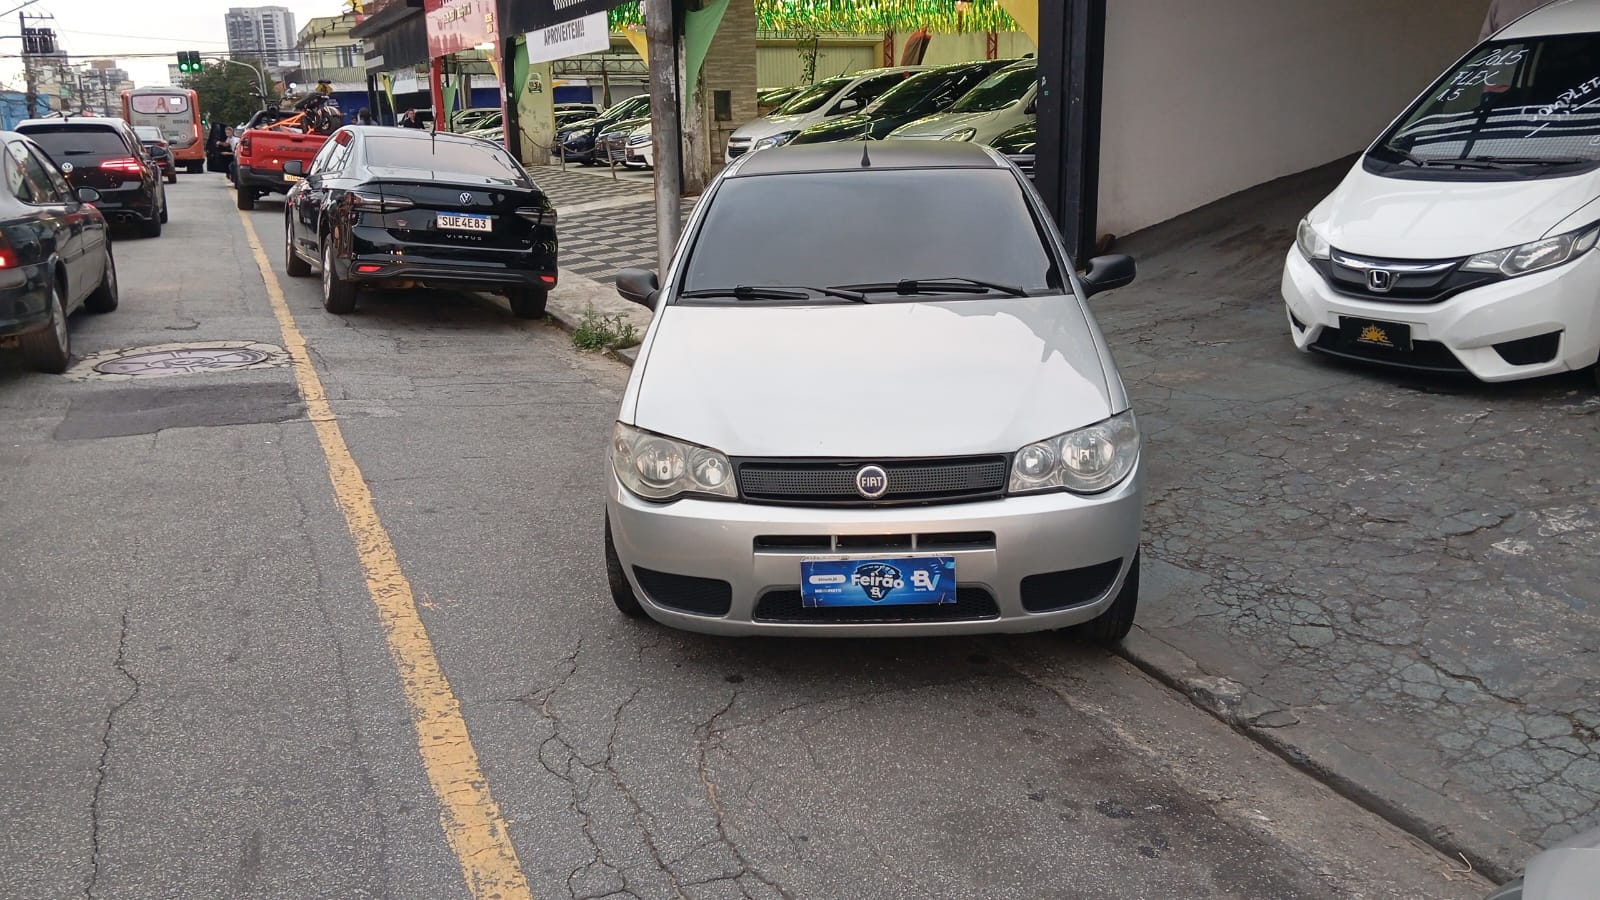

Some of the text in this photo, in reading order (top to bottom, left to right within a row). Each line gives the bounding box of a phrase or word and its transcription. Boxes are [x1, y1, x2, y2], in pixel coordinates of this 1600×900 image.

[543, 18, 585, 46] APROVEITEM!!
[1467, 48, 1529, 67] 2015
[1450, 70, 1500, 86] FLEX
[1436, 88, 1465, 102] 1.5
[1521, 76, 1600, 122] COMPLET
[442, 216, 487, 230] SUE4E83
[446, 233, 482, 241] VIRTUS
[861, 475, 883, 489] FIAT
[851, 572, 905, 589] Feirão
[910, 570, 941, 591] BV
